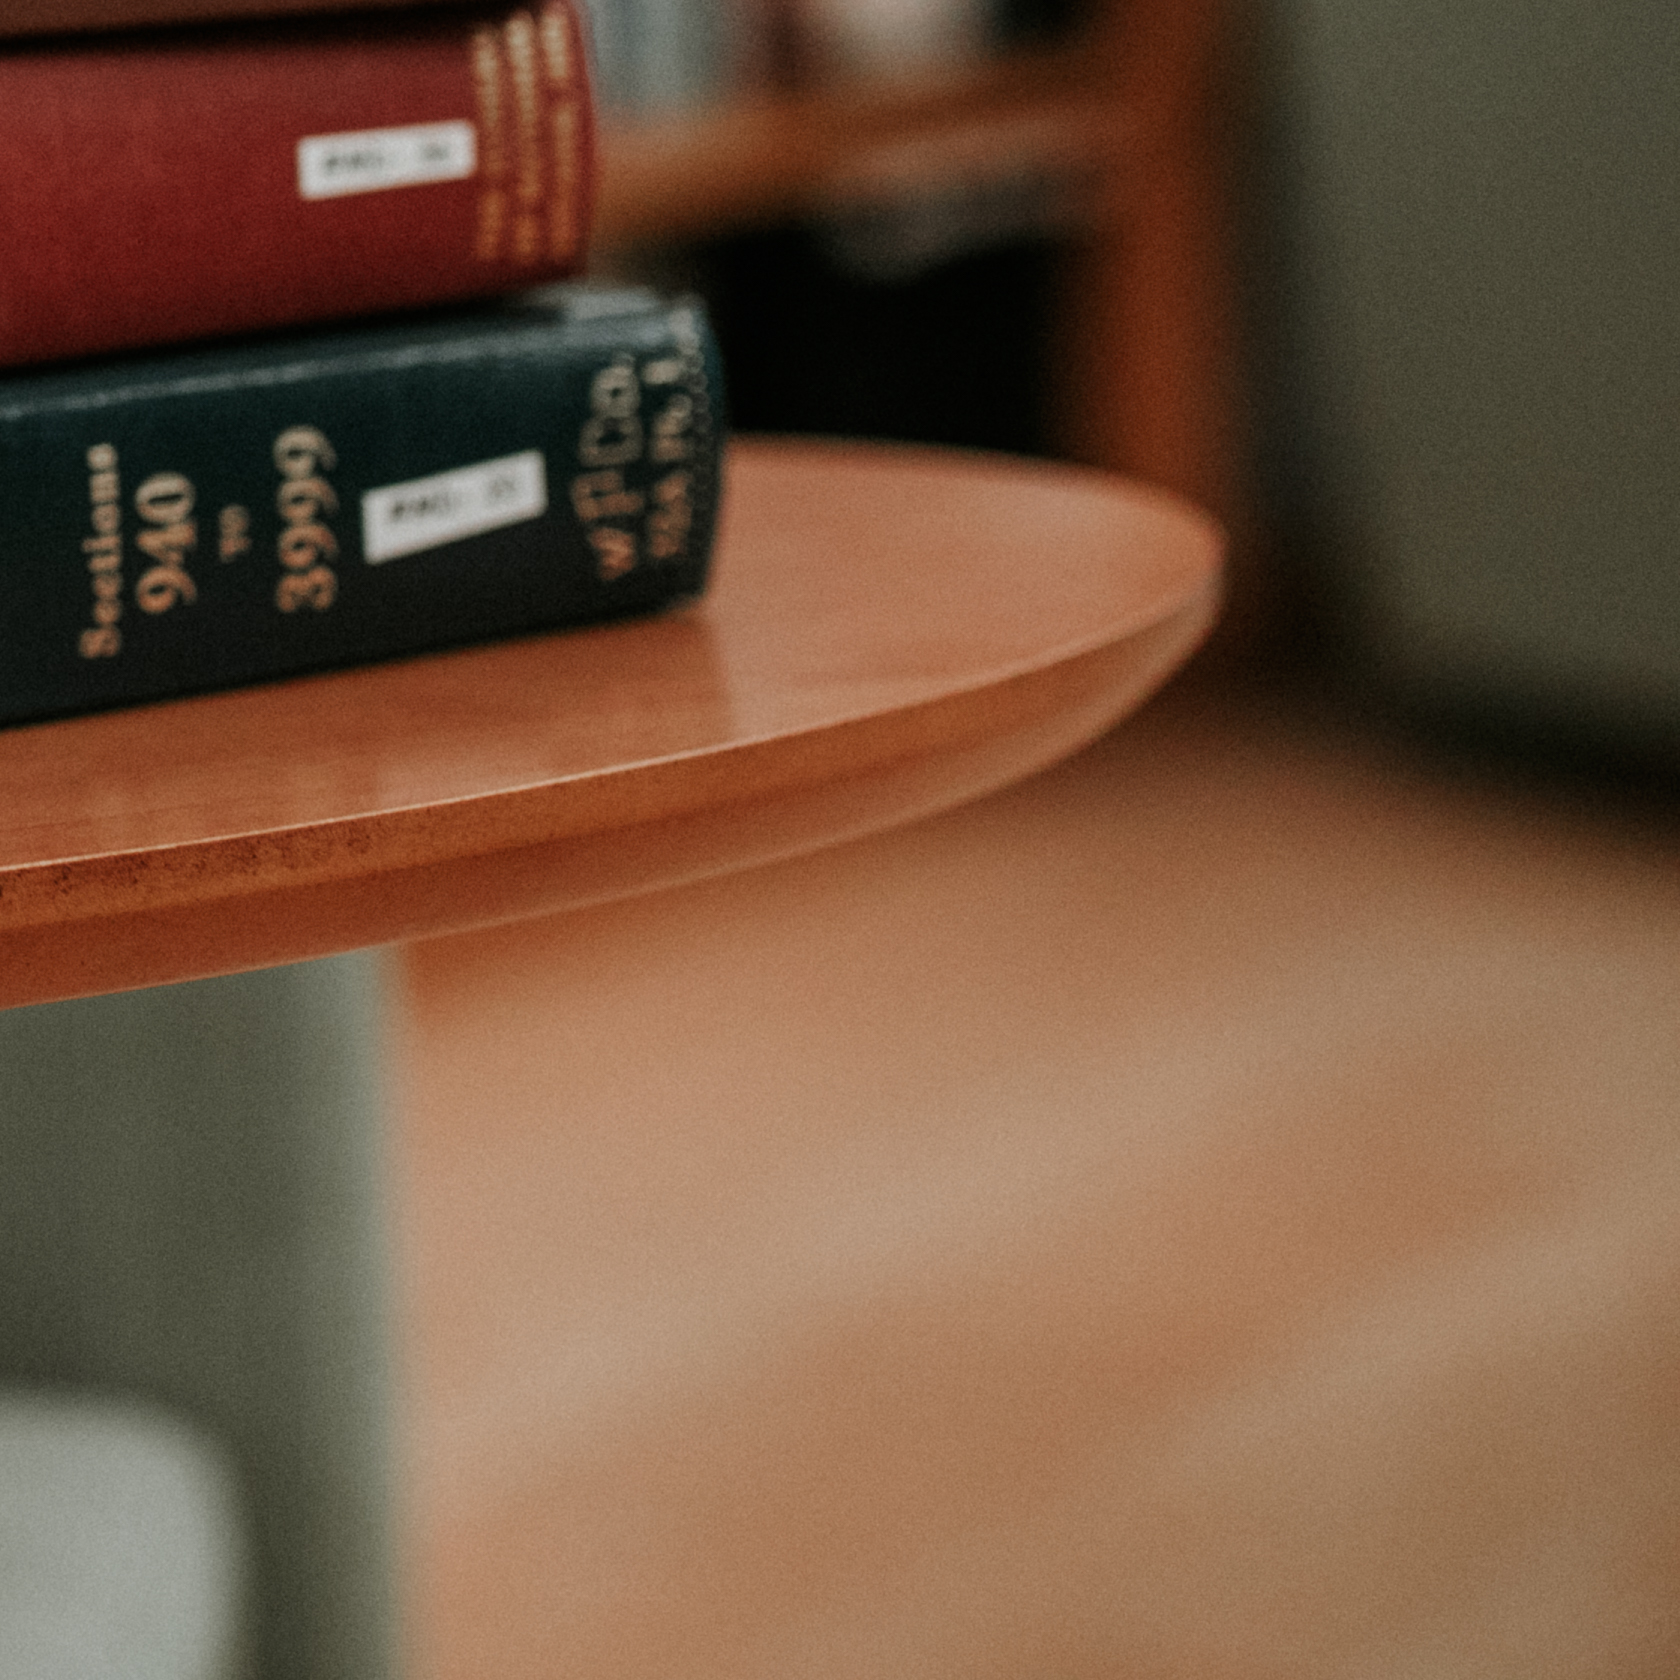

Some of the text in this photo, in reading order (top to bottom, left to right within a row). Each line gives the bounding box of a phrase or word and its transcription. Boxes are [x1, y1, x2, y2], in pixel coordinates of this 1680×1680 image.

[80, 441, 123, 659] Sections
[134, 472, 196, 614] 940
[273, 425, 336, 611] 3999
